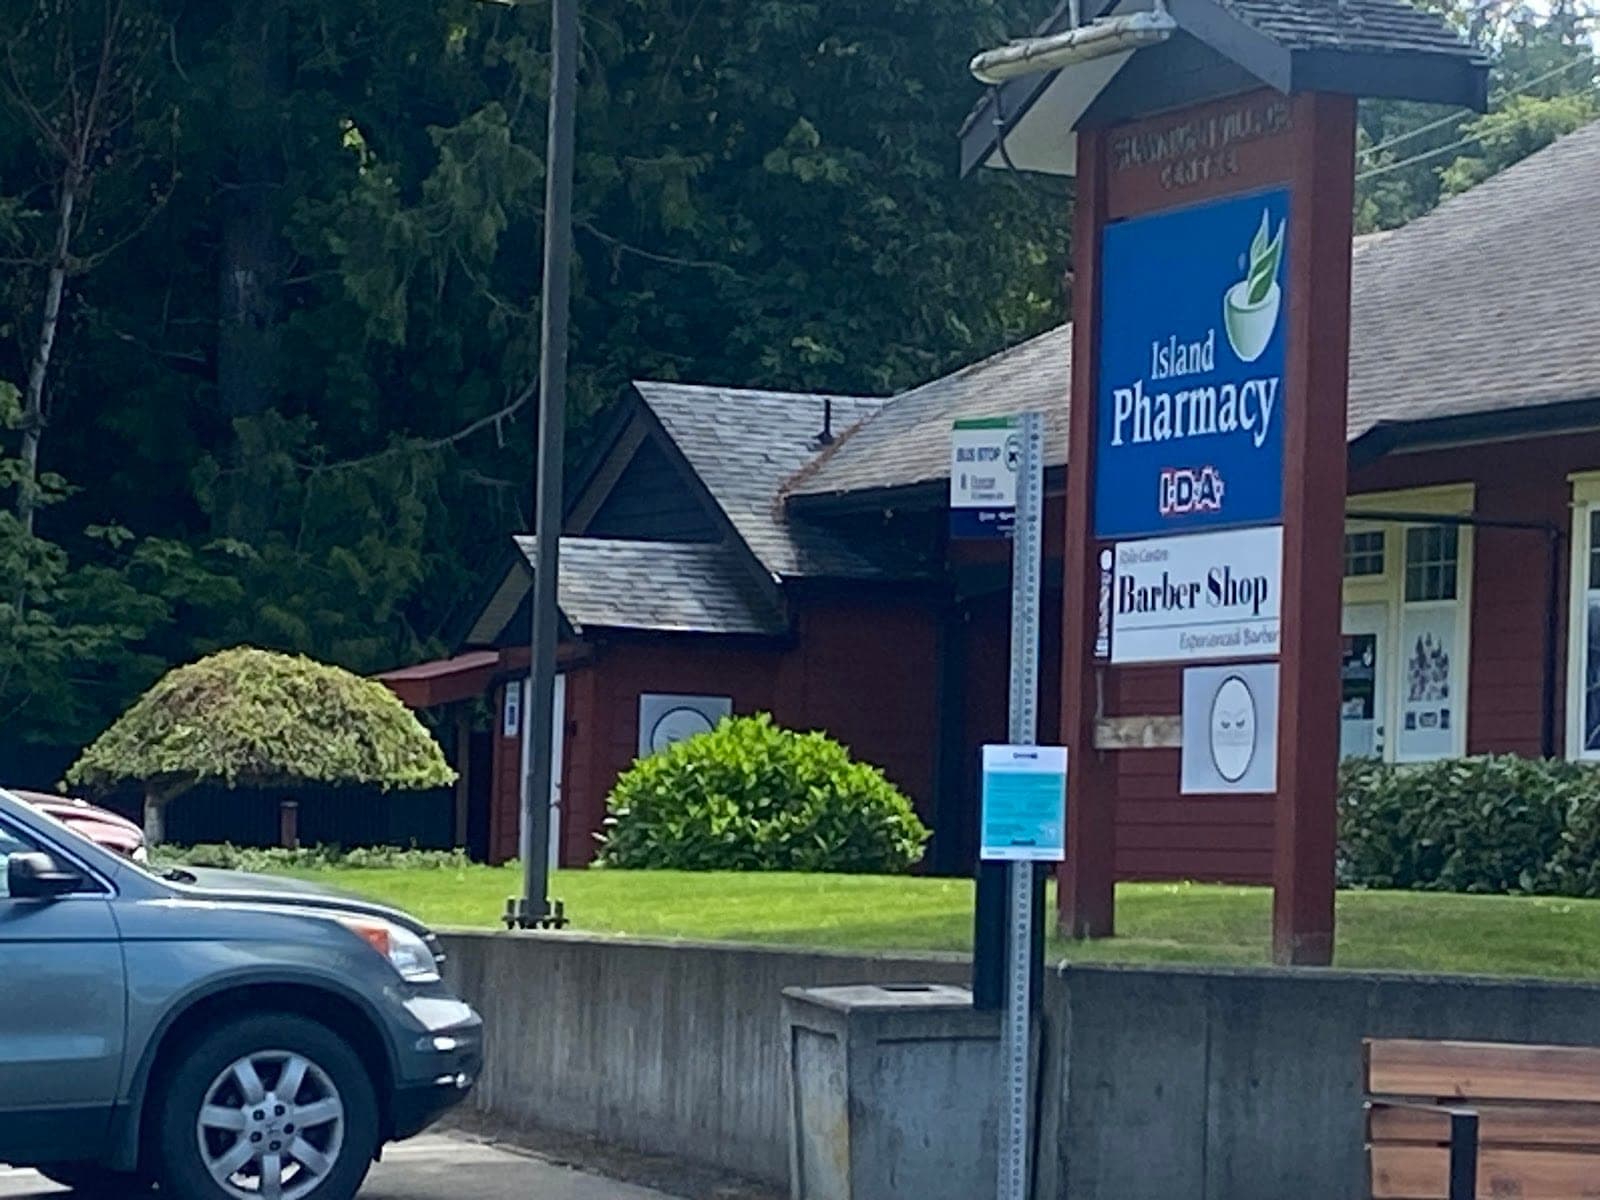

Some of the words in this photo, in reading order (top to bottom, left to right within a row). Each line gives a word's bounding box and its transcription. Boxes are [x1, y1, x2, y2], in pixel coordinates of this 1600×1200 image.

[1151, 329, 1215, 380] Island
[1111, 377, 1279, 448] Pharmacy
[956, 447, 975, 462] BUS
[977, 446, 1001, 462] STOP
[1118, 571, 1201, 614] Barber
[1207, 565, 1268, 616] Shop
